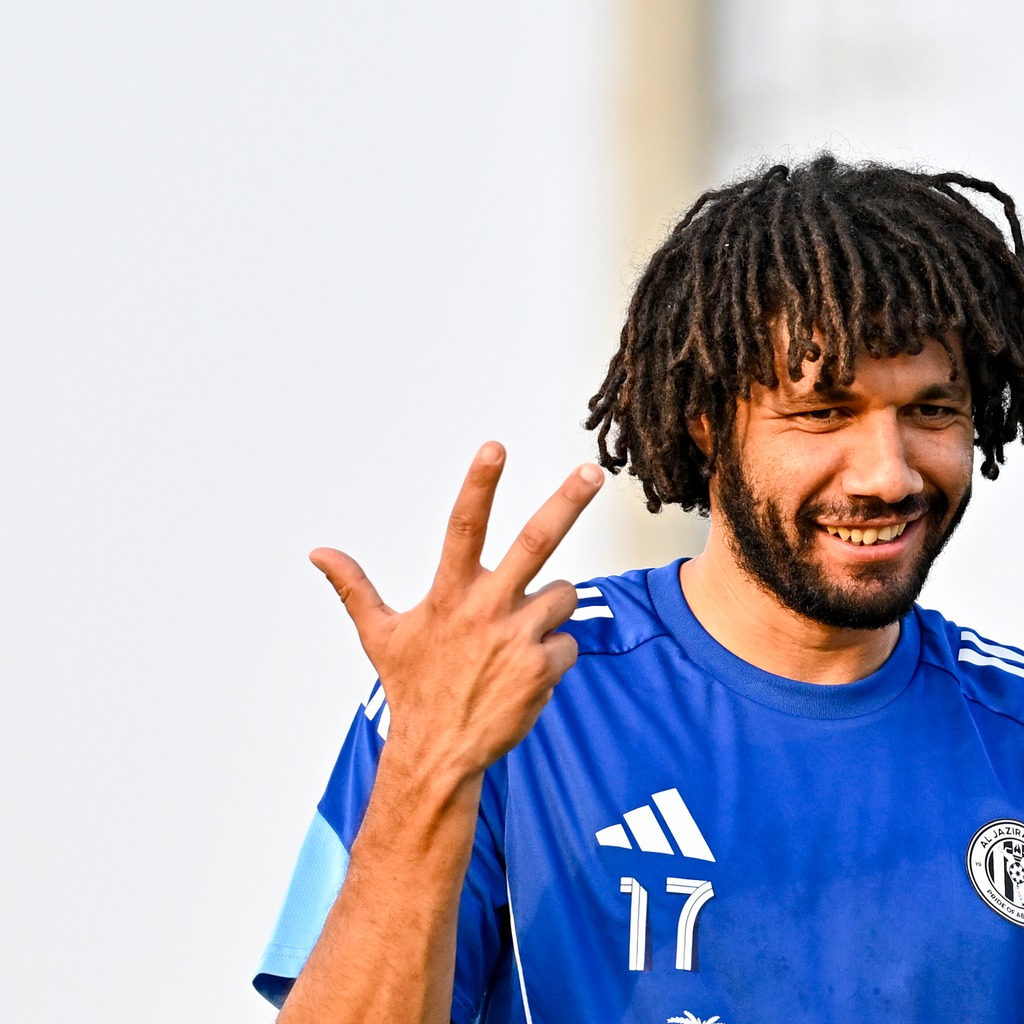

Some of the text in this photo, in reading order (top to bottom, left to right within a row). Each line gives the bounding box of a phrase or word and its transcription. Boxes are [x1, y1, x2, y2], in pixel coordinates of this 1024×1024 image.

[980, 836, 992, 849] AL
[986, 889, 1006, 908] PRIDE
[1006, 907, 1017, 915] OF
[620, 877, 715, 971] 17
